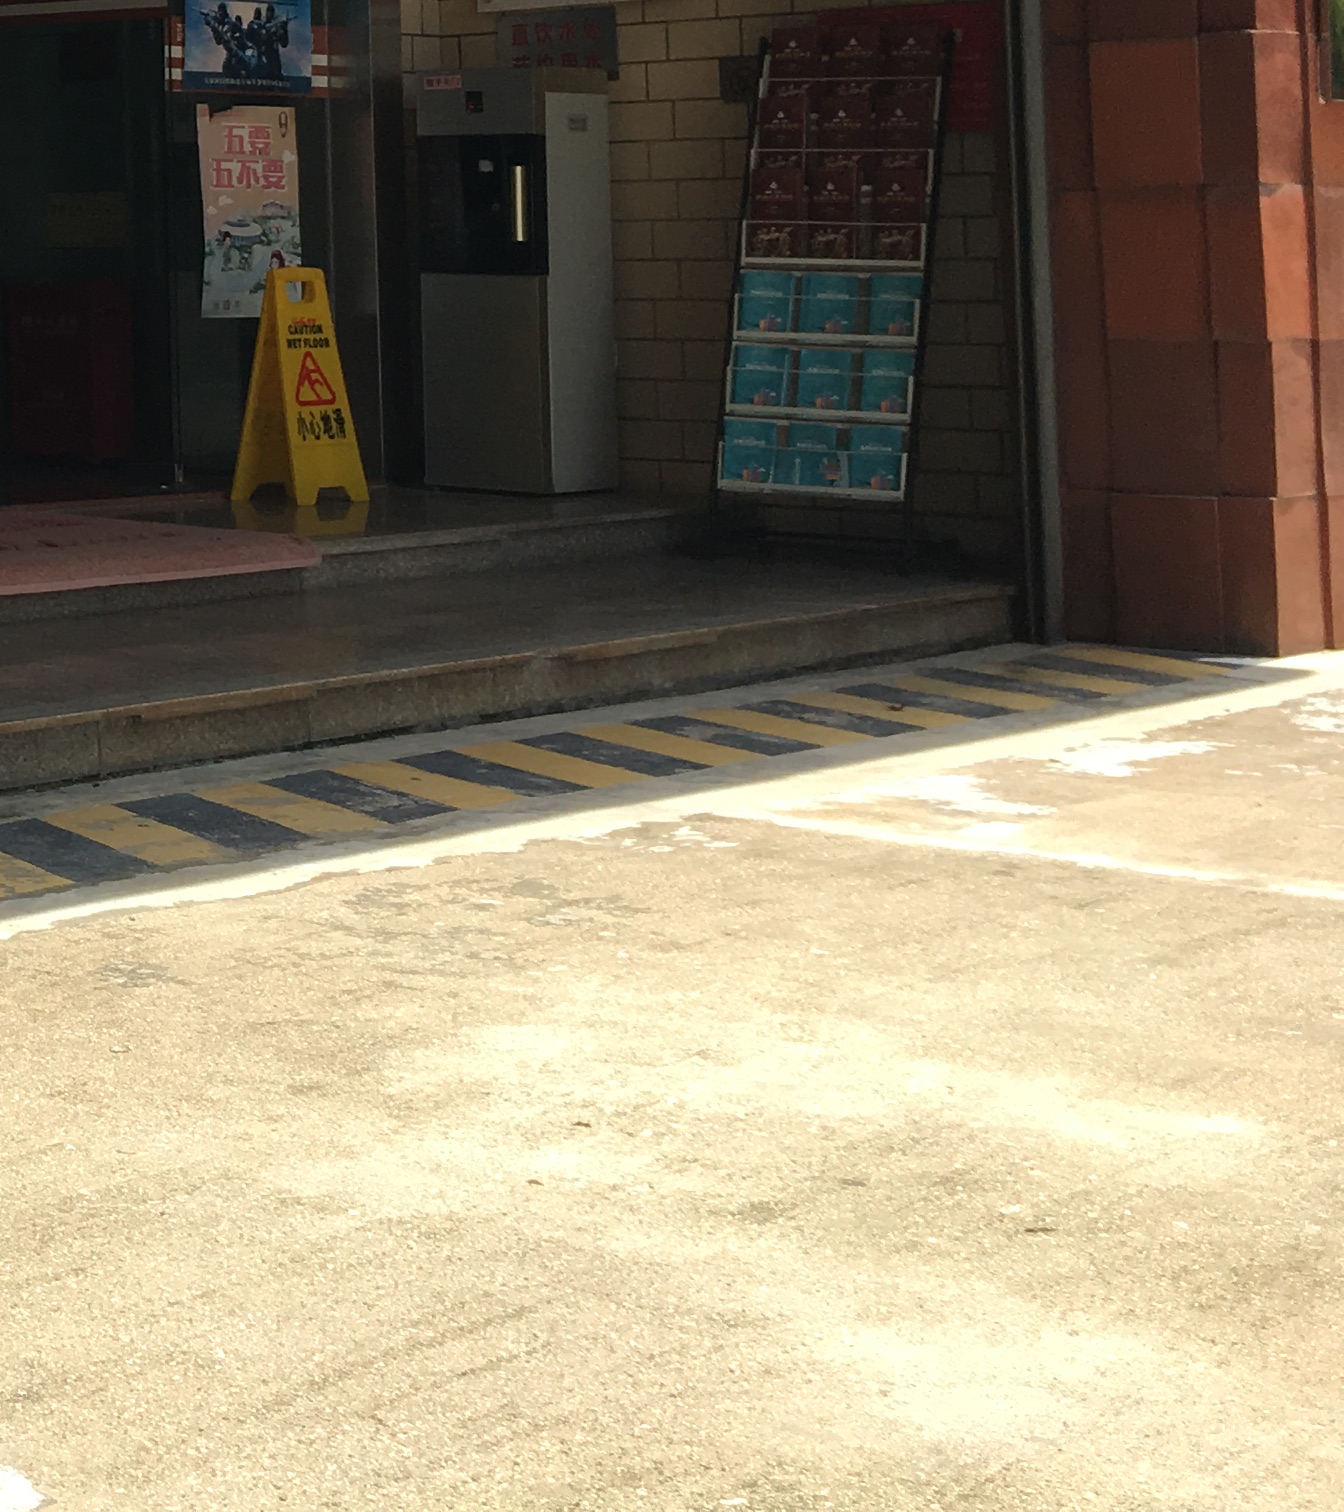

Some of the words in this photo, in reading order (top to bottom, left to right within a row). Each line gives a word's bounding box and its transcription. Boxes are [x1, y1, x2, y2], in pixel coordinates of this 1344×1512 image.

[222, 122, 273, 157] 五要
[210, 158, 286, 192] 五不要
[285, 337, 302, 349] WET
[303, 337, 330, 349] FLOOR
[287, 323, 324, 336] CAUTION
[296, 408, 347, 442] 小心地滑
